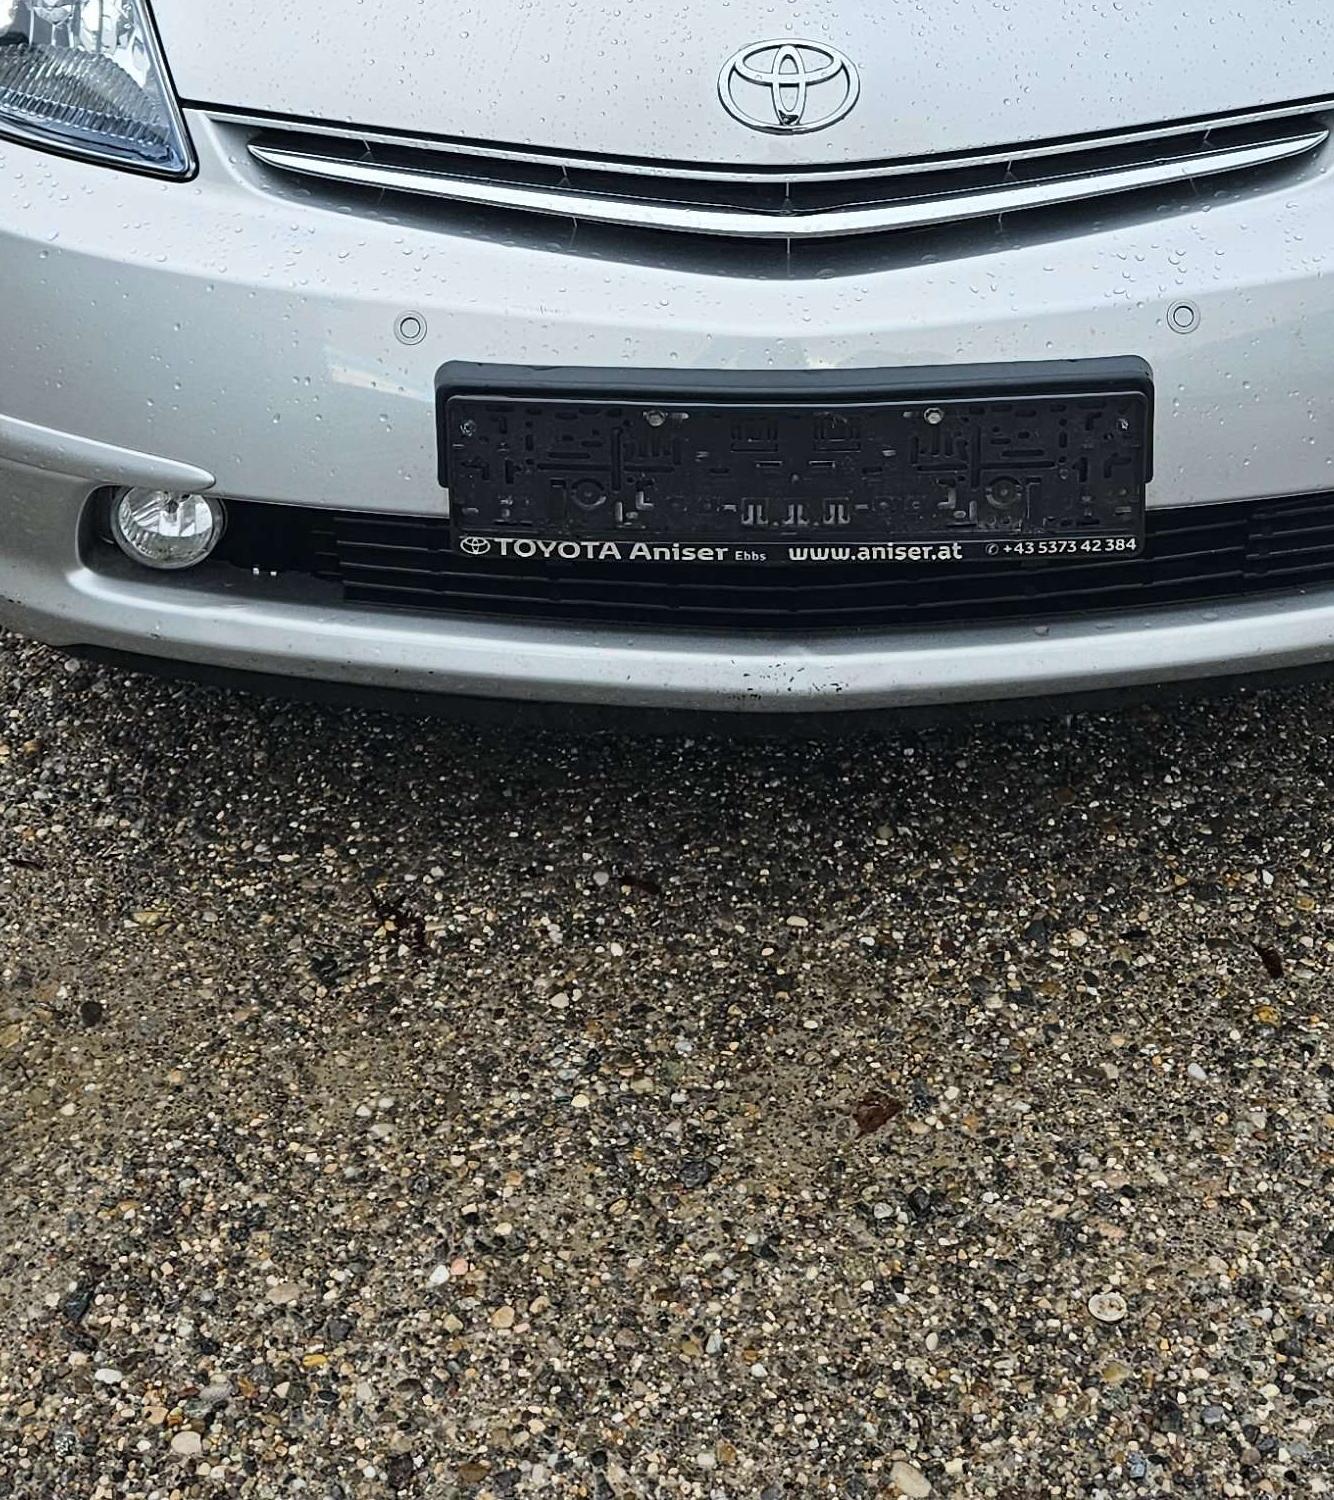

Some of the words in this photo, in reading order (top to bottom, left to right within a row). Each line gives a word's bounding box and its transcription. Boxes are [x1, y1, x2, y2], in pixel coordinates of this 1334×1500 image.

[494, 538, 622, 560] TOYOTA
[629, 542, 729, 561] Aniser
[735, 550, 767, 562] Ebbs
[788, 542, 963, 561] www.aniser.at
[1003, 542, 1035, 555] +43
[1038, 540, 1077, 554] 5373
[1080, 539, 1103, 553] 42
[1104, 538, 1138, 551] 384
